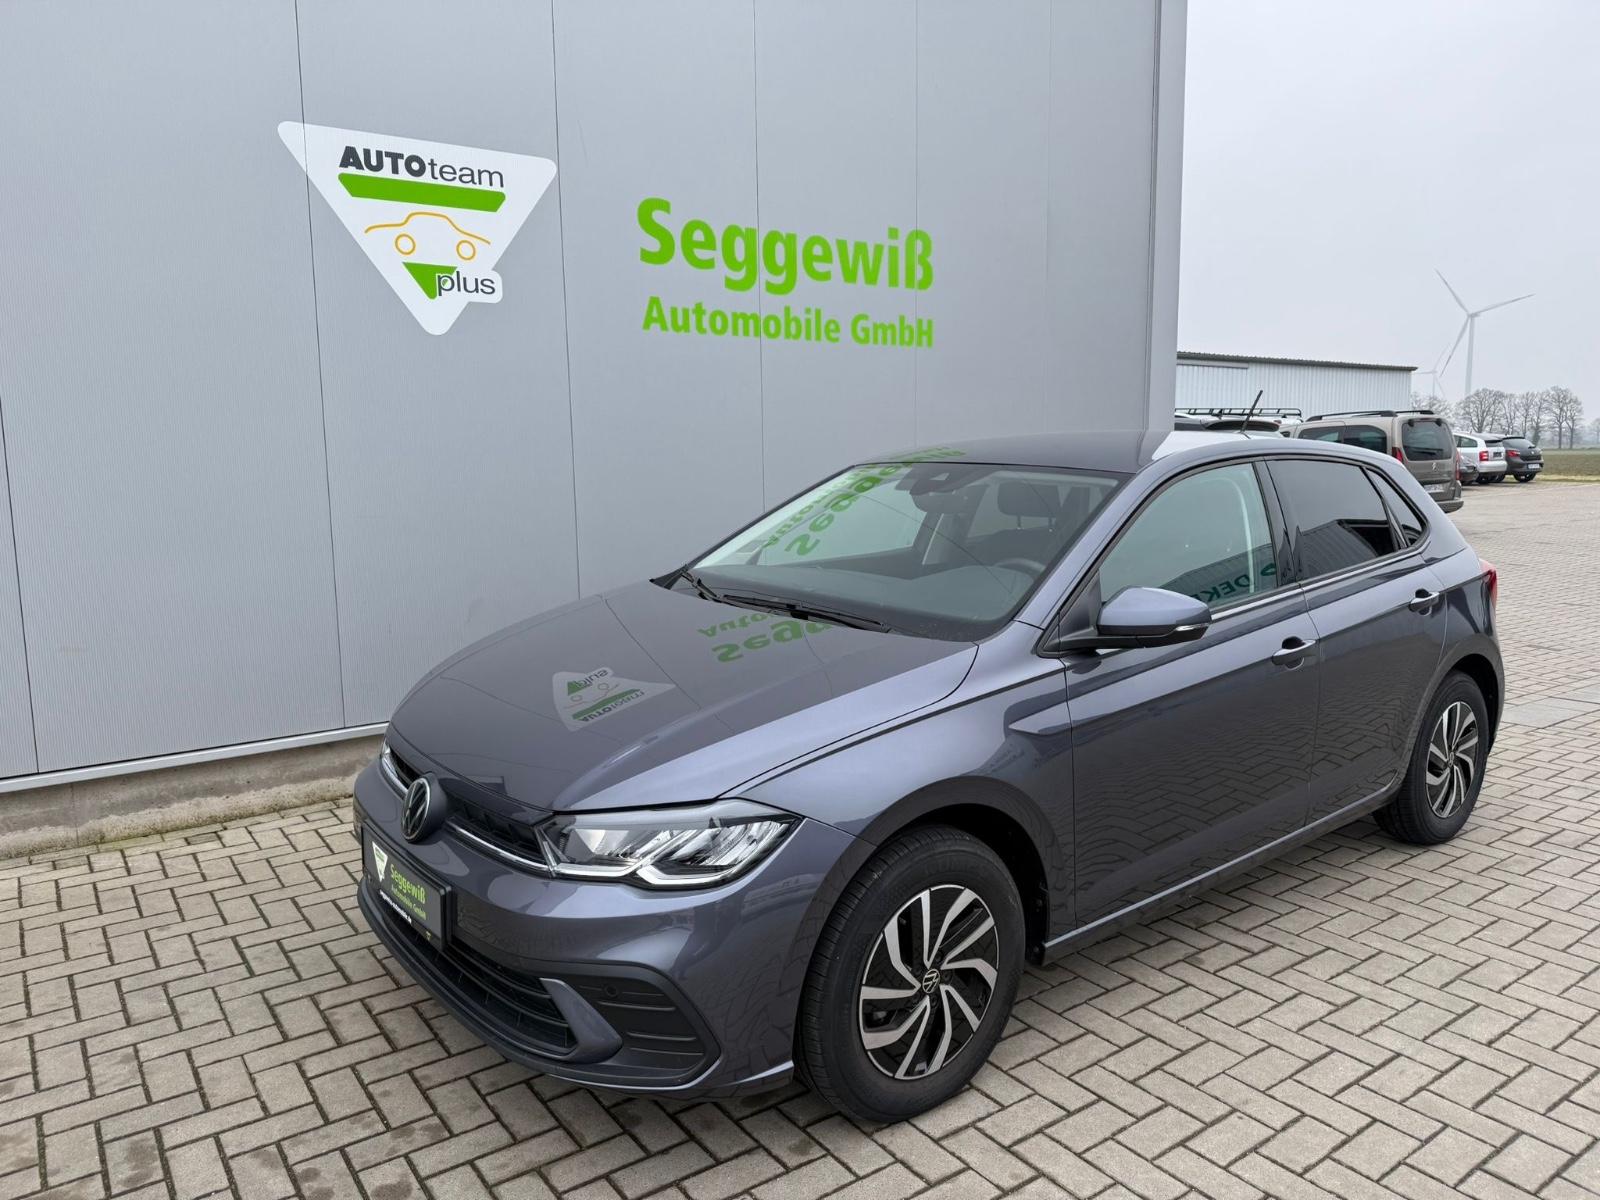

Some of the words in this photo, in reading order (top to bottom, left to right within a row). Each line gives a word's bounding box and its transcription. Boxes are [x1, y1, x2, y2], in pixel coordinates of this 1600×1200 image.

[338, 145, 505, 188] AUTOteam
[636, 197, 934, 296] Seggewiß
[436, 270, 496, 297] plus
[641, 295, 841, 344] Automobile
[850, 312, 934, 348] GmbH
[390, 863, 426, 905] Seggewiß
